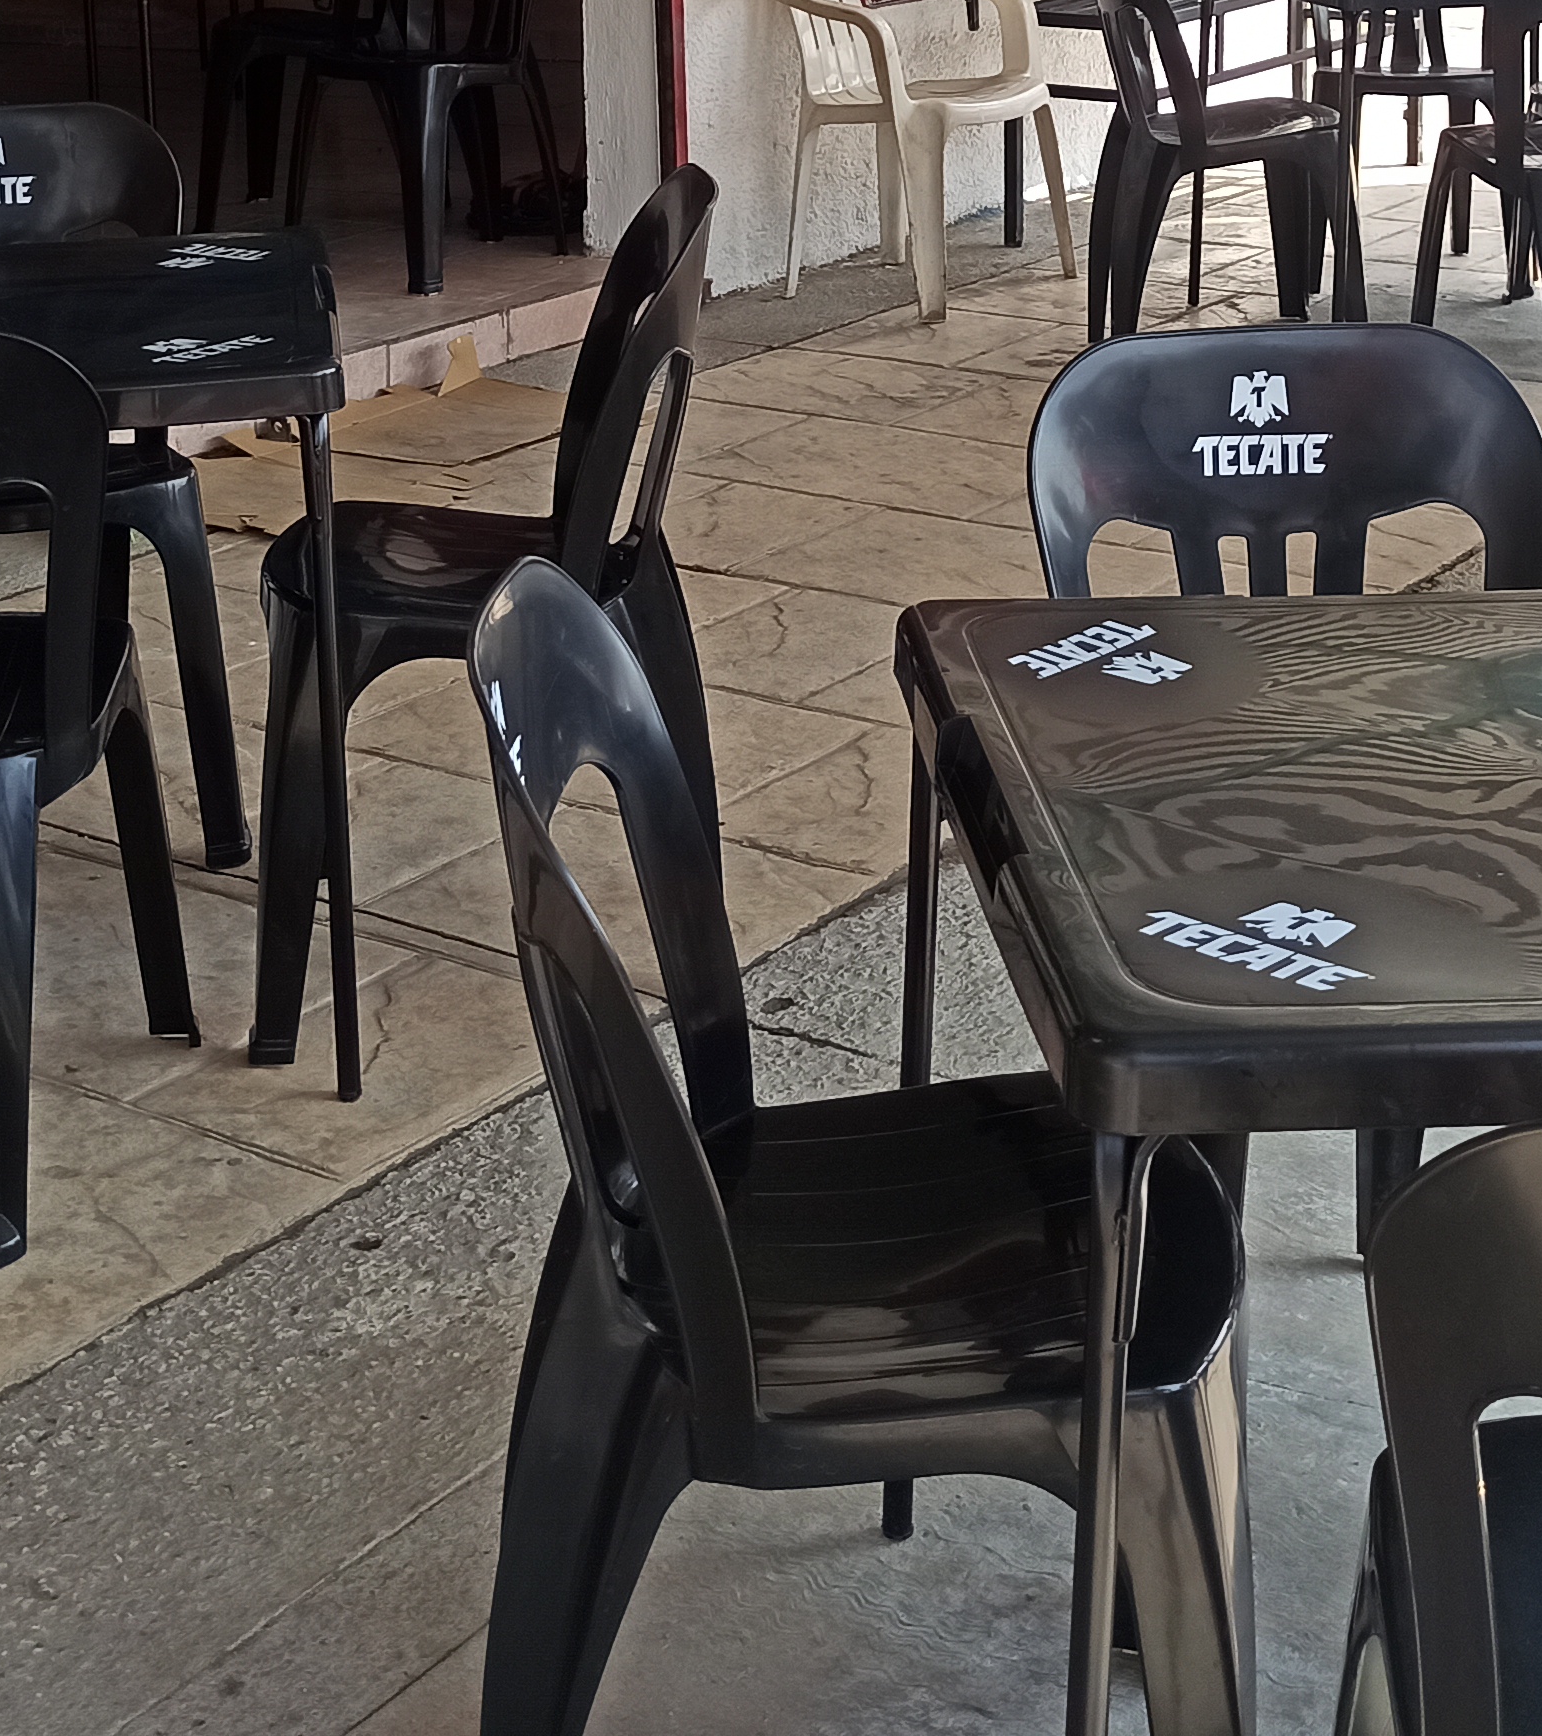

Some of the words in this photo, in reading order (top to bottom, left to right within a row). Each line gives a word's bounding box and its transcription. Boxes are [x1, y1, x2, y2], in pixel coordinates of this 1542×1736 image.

[152, 334, 274, 363] TECATE
[1192, 433, 1333, 477] TECATE
[1008, 620, 1156, 679] TECATE
[1139, 910, 1376, 991] TECATE
